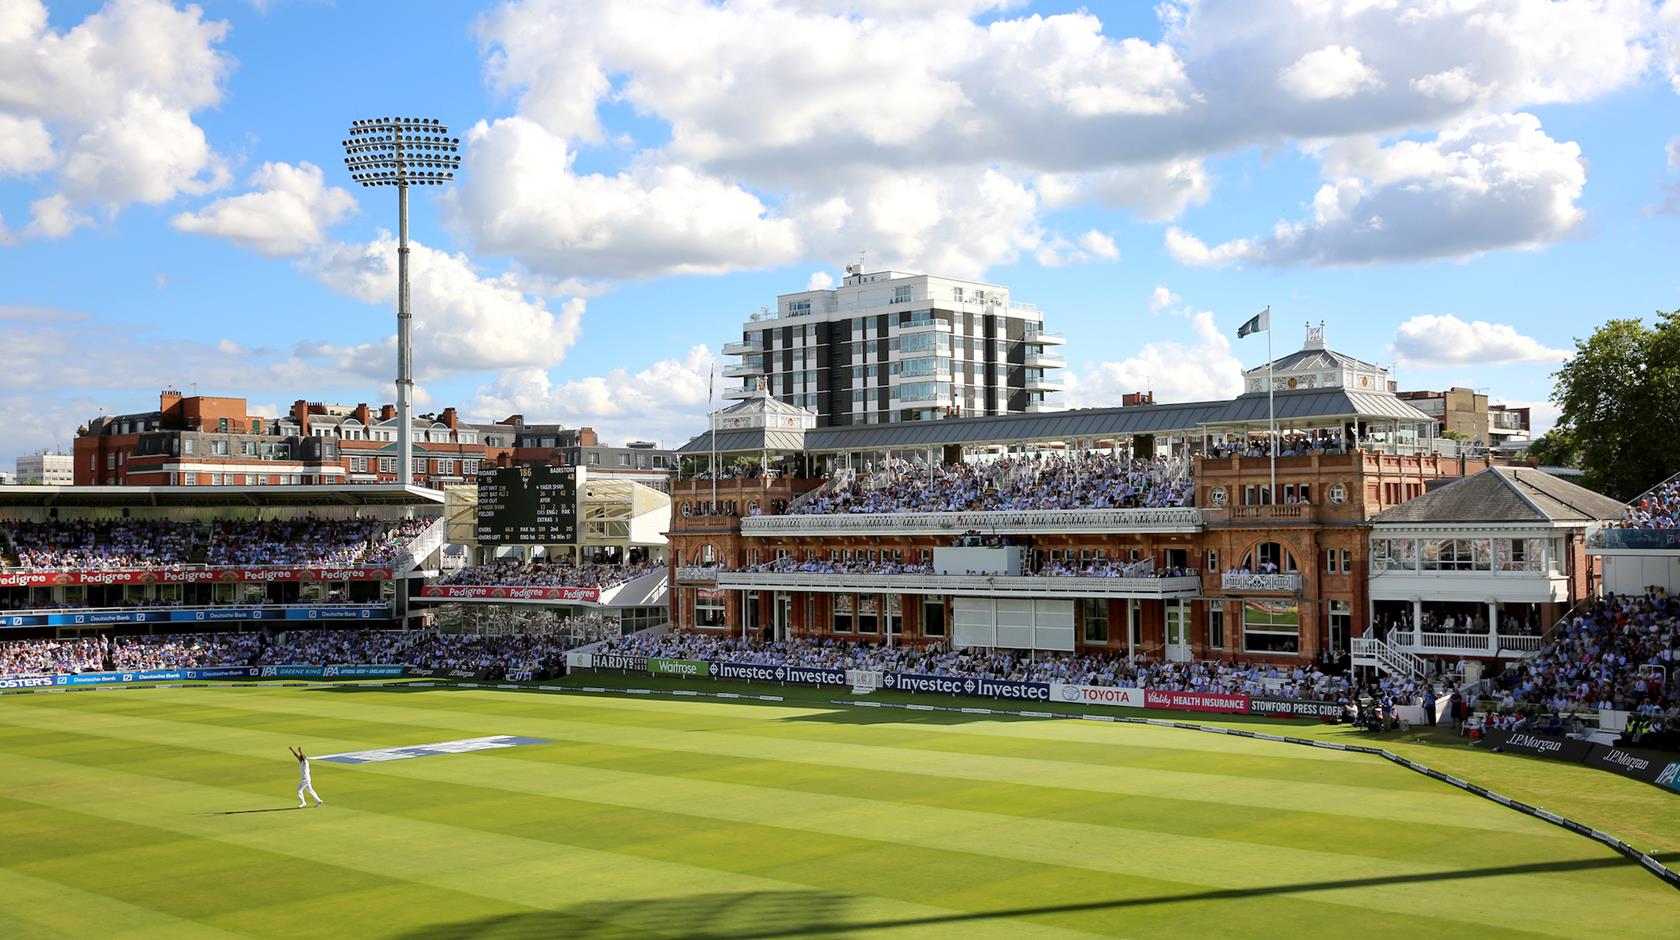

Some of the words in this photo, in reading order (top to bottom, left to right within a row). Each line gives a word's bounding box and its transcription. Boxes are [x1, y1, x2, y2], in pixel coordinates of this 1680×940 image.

[520, 468, 532, 477] 186
[0, 575, 46, 586] edigree
[80, 572, 131, 584] Pedigree
[164, 571, 213, 582] Pedigree
[244, 570, 291, 581] Pedigree
[321, 570, 364, 580] Pedigree
[449, 588, 486, 597] Pedigree
[510, 588, 543, 598] Pedigree
[564, 590, 594, 600] Pedigree
[261, 667, 277, 677] IPA
[323, 667, 340, 677] IPA
[659, 660, 696, 674] Waitrose
[720, 663, 773, 680] Investec
[786, 667, 844, 684] Investec
[897, 675, 962, 692] Investec
[978, 680, 1047, 699] Investec
[1082, 688, 1130, 702] TOYOTA
[1148, 691, 1171, 707] Vitality
[1174, 696, 1200, 706] HEALTH
[1202, 697, 1244, 709] INSURANCE
[1252, 700, 1291, 713] STOWFORD
[1293, 703, 1317, 714] PRESS
[1319, 704, 1342, 716] CIDER
[1506, 734, 1562, 752] J.P.Morgan
[1603, 750, 1649, 770] J.P.Morgan
[1655, 762, 1680, 784] IPA
